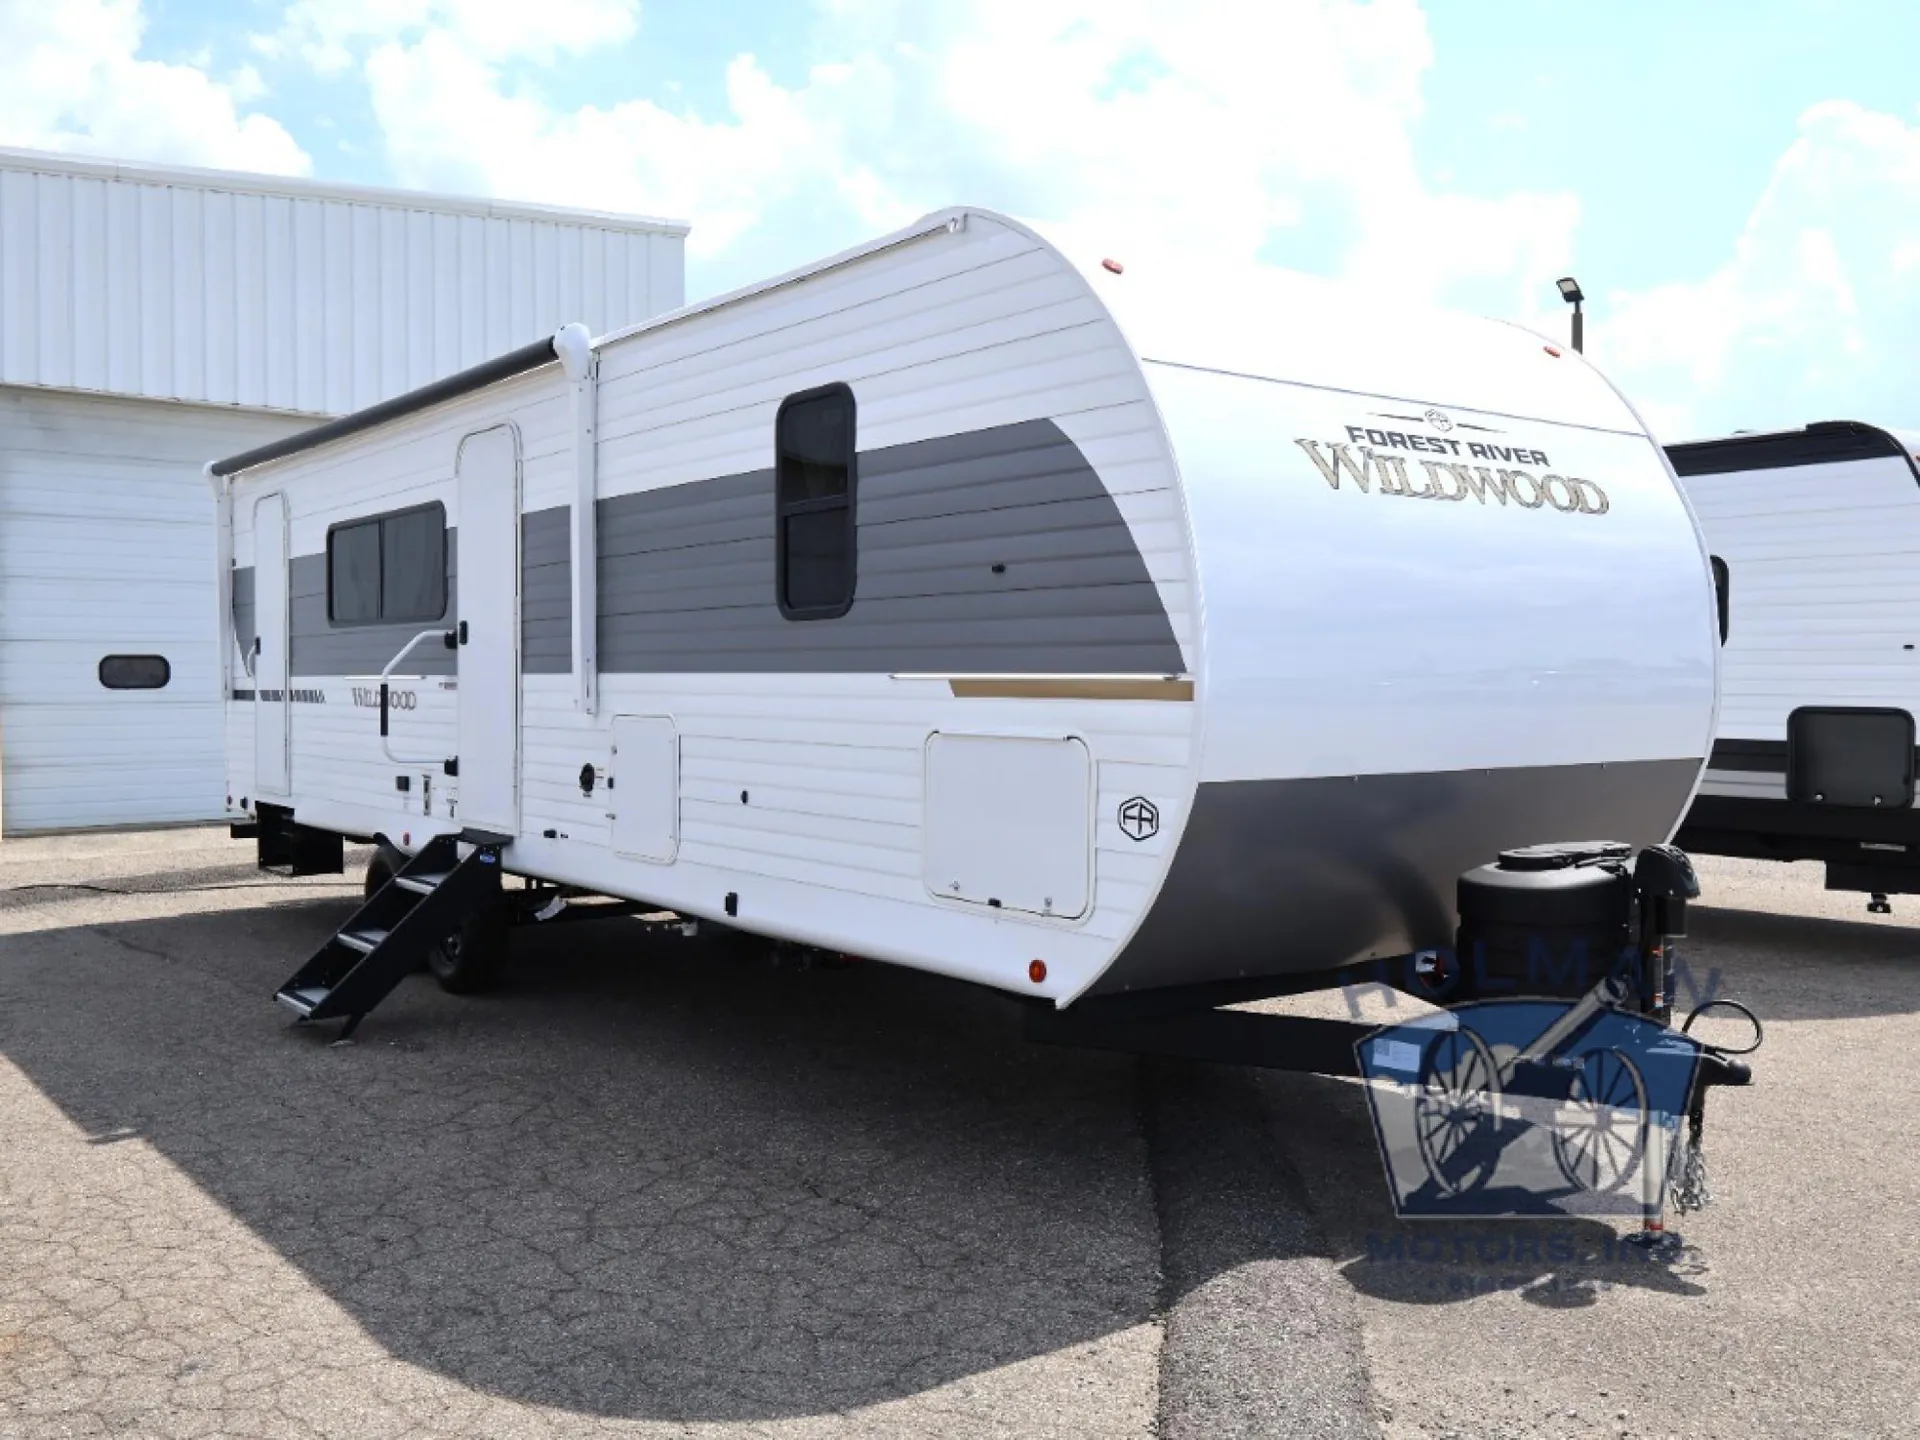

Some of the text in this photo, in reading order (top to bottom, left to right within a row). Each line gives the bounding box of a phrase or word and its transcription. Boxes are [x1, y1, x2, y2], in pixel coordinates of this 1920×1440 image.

[1345, 425, 1551, 467] FOREST RIVER
[1294, 438, 1610, 515] WILDWOOD
[351, 687, 417, 710] WILDOOD
